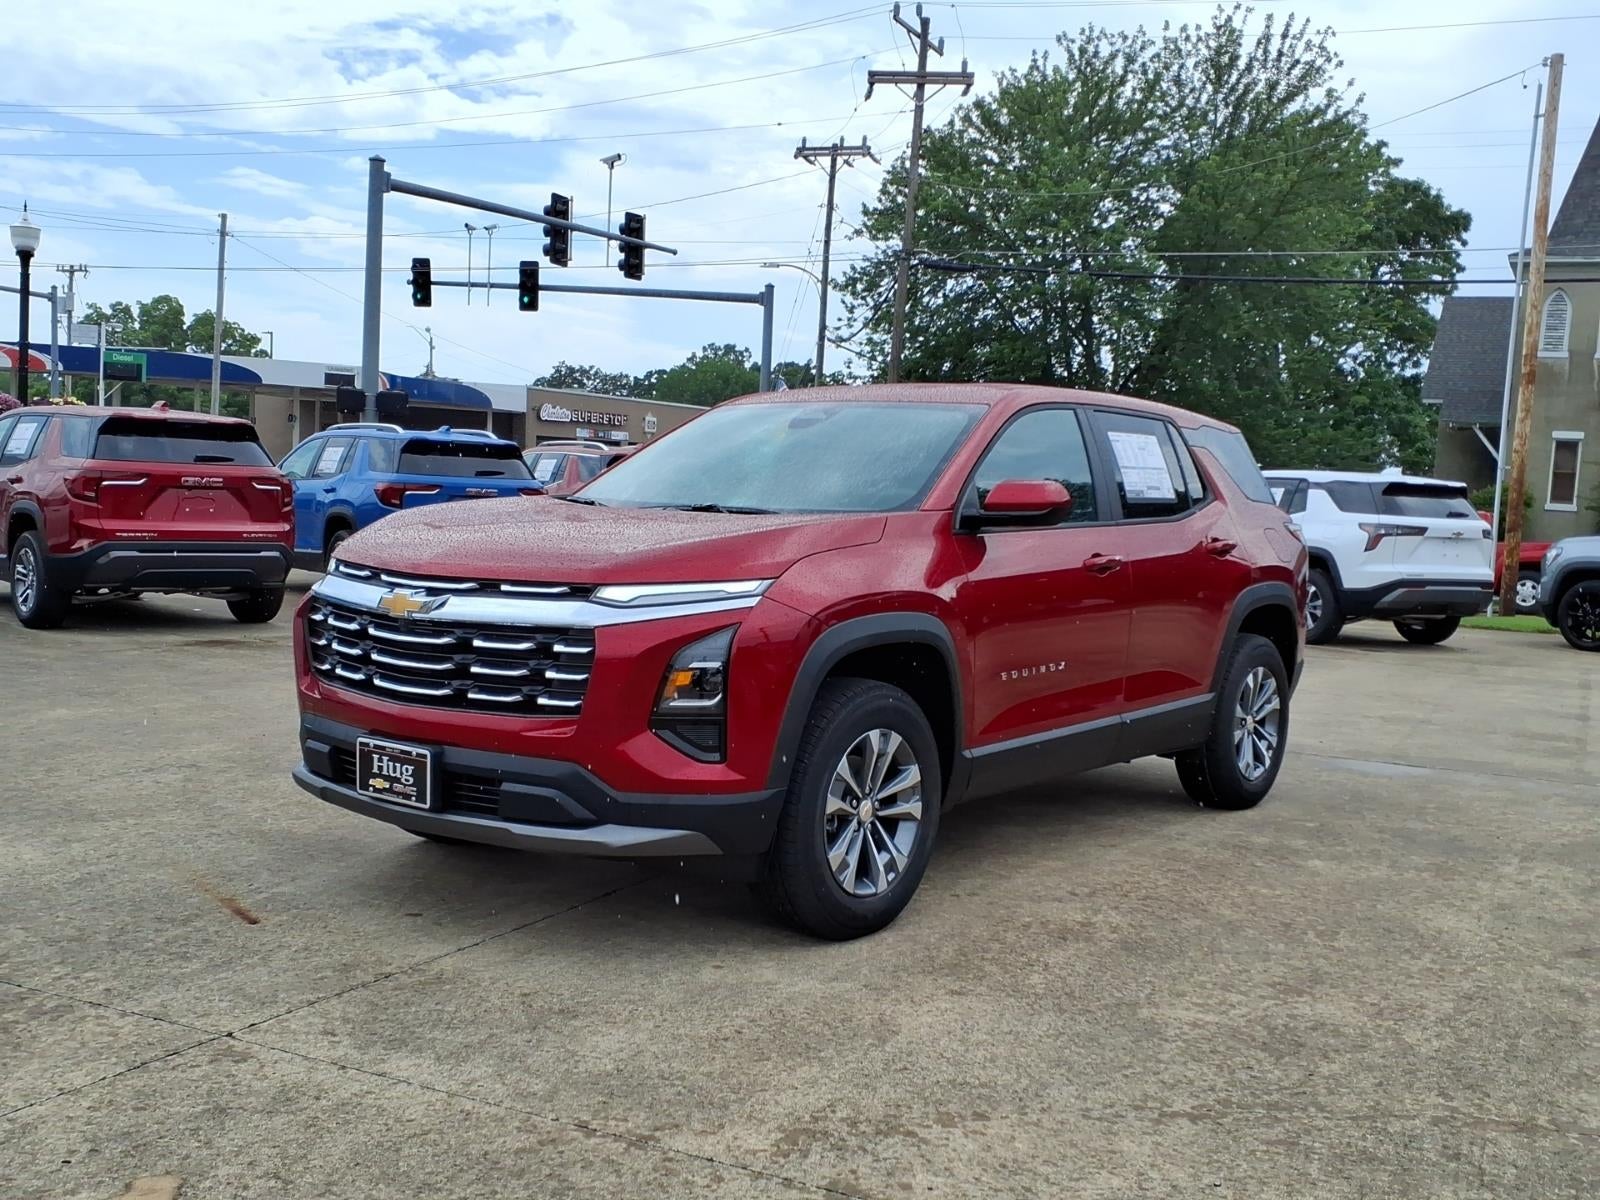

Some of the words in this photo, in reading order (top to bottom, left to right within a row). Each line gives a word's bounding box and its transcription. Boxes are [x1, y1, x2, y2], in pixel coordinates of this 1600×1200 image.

[112, 353, 134, 362] Diesel
[572, 409, 628, 426] SUPERSTOP
[181, 476, 224, 487] GMC
[1000, 661, 1066, 681] EQUINOX
[371, 754, 415, 785] Hug
[392, 783, 417, 796] GMC
